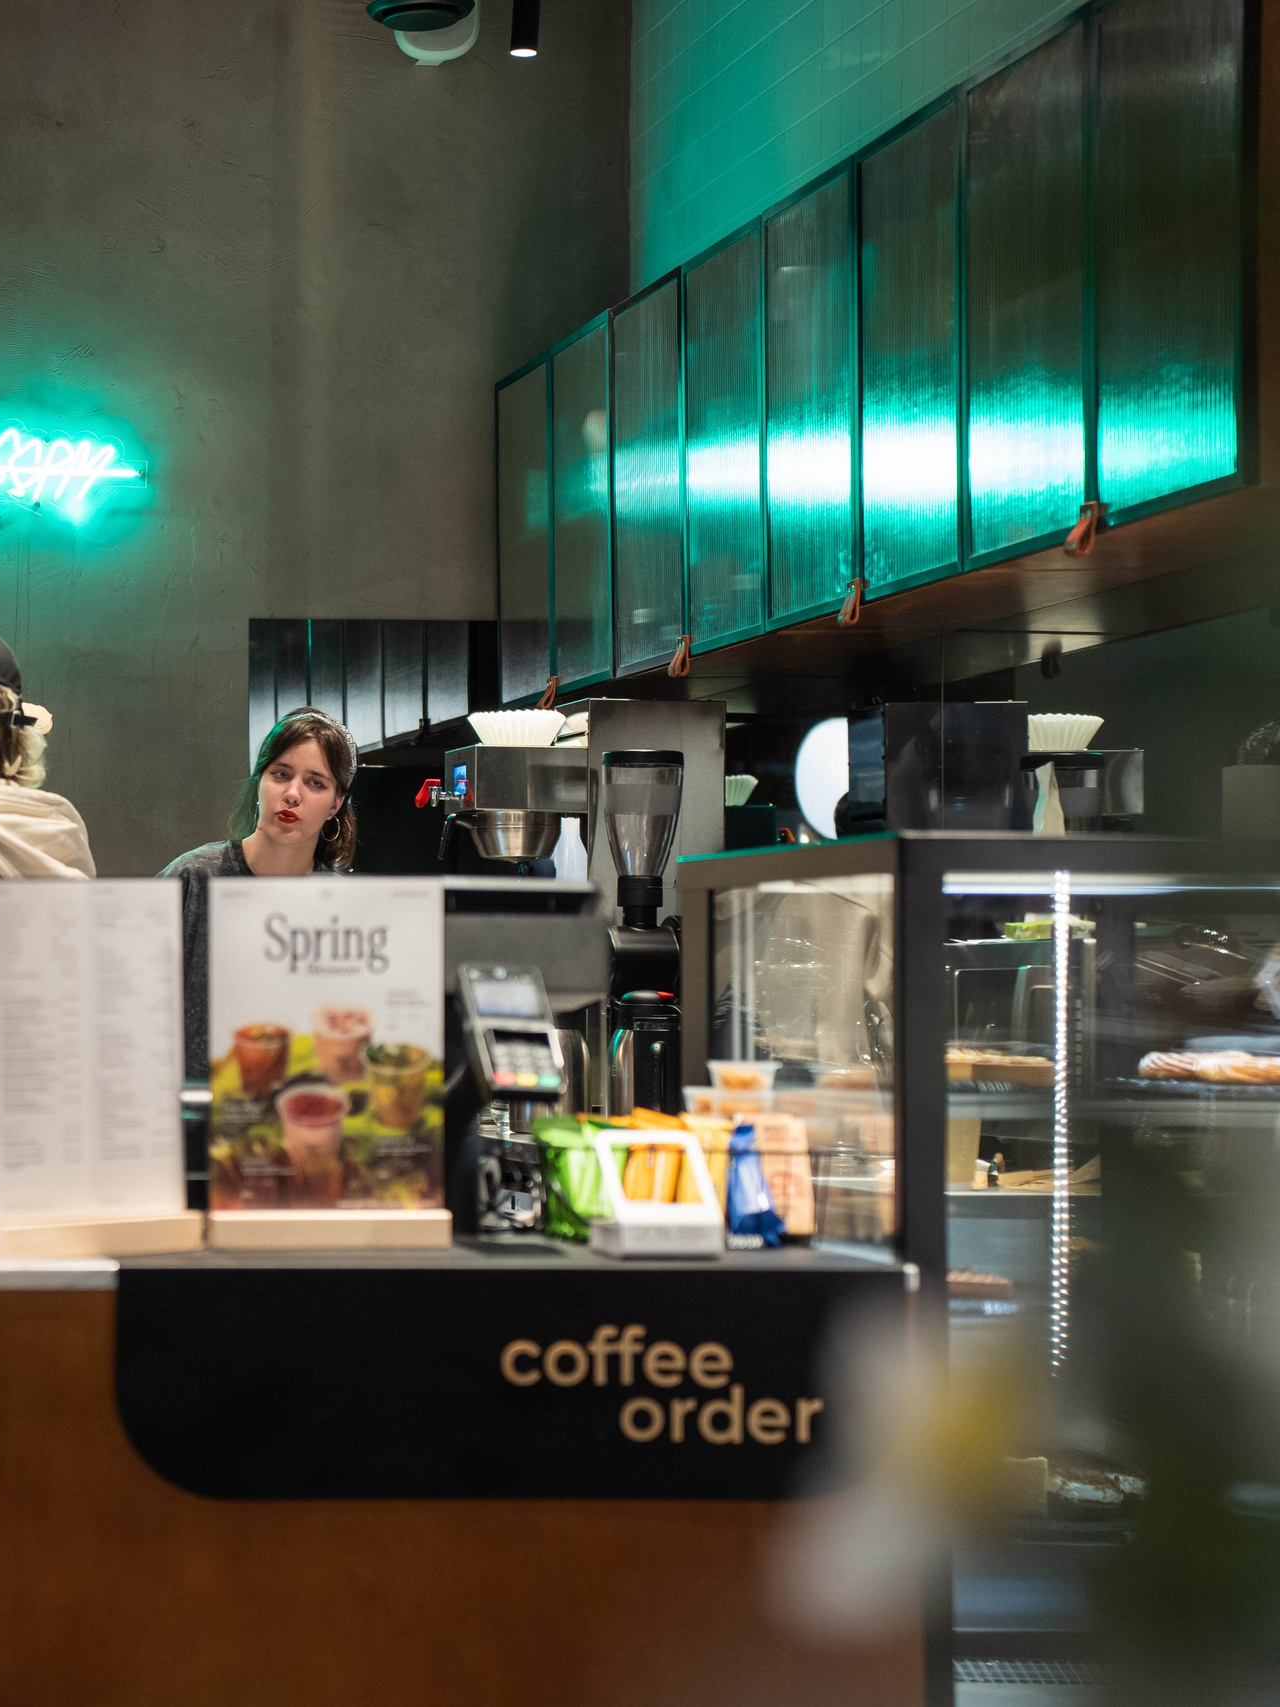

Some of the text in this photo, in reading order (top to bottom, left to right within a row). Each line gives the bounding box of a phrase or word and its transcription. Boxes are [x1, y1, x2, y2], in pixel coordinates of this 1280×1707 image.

[264, 912, 390, 976] Spring
[499, 1323, 735, 1389] coffee
[618, 1383, 825, 1445] order
